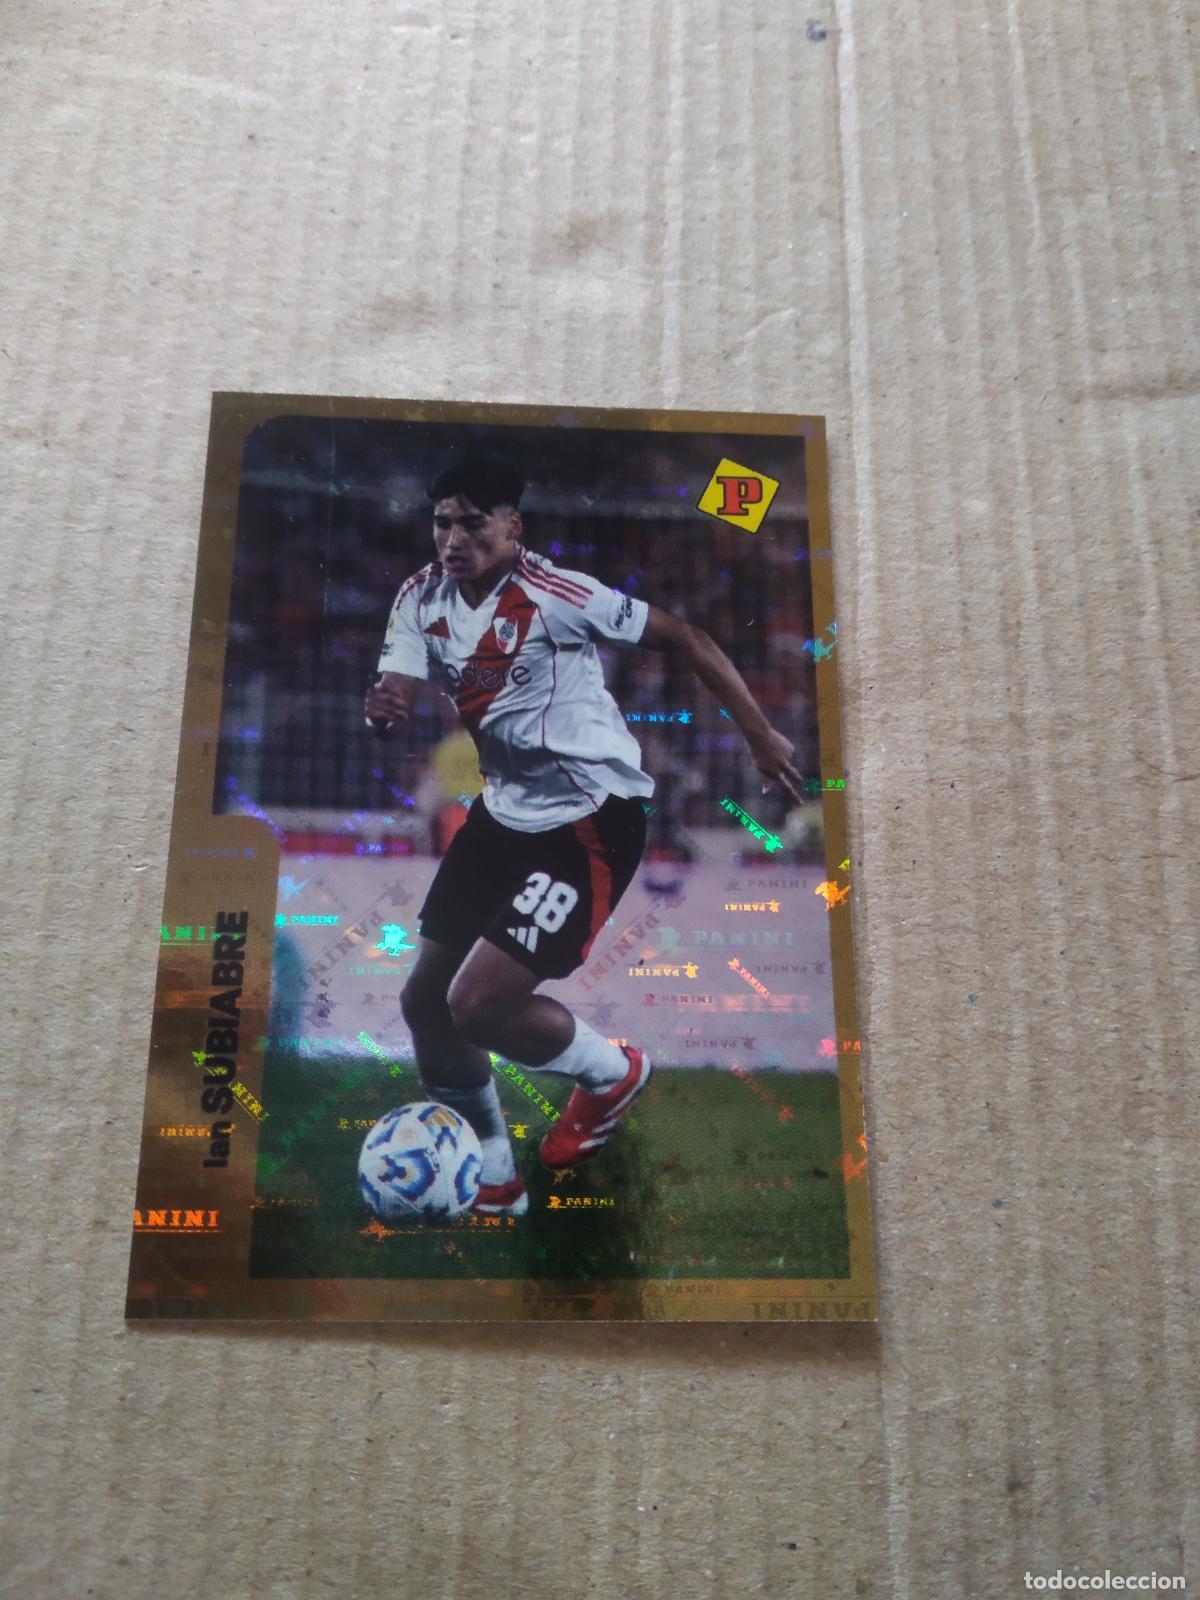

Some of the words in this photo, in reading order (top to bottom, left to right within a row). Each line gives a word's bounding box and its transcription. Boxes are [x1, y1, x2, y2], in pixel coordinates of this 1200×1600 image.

[716, 475, 763, 516] P
[512, 872, 579, 934] 38
[201, 911, 249, 1114] SUBIABRE
[202, 1121, 232, 1168] Ian
[134, 1209, 218, 1227] ANINI
